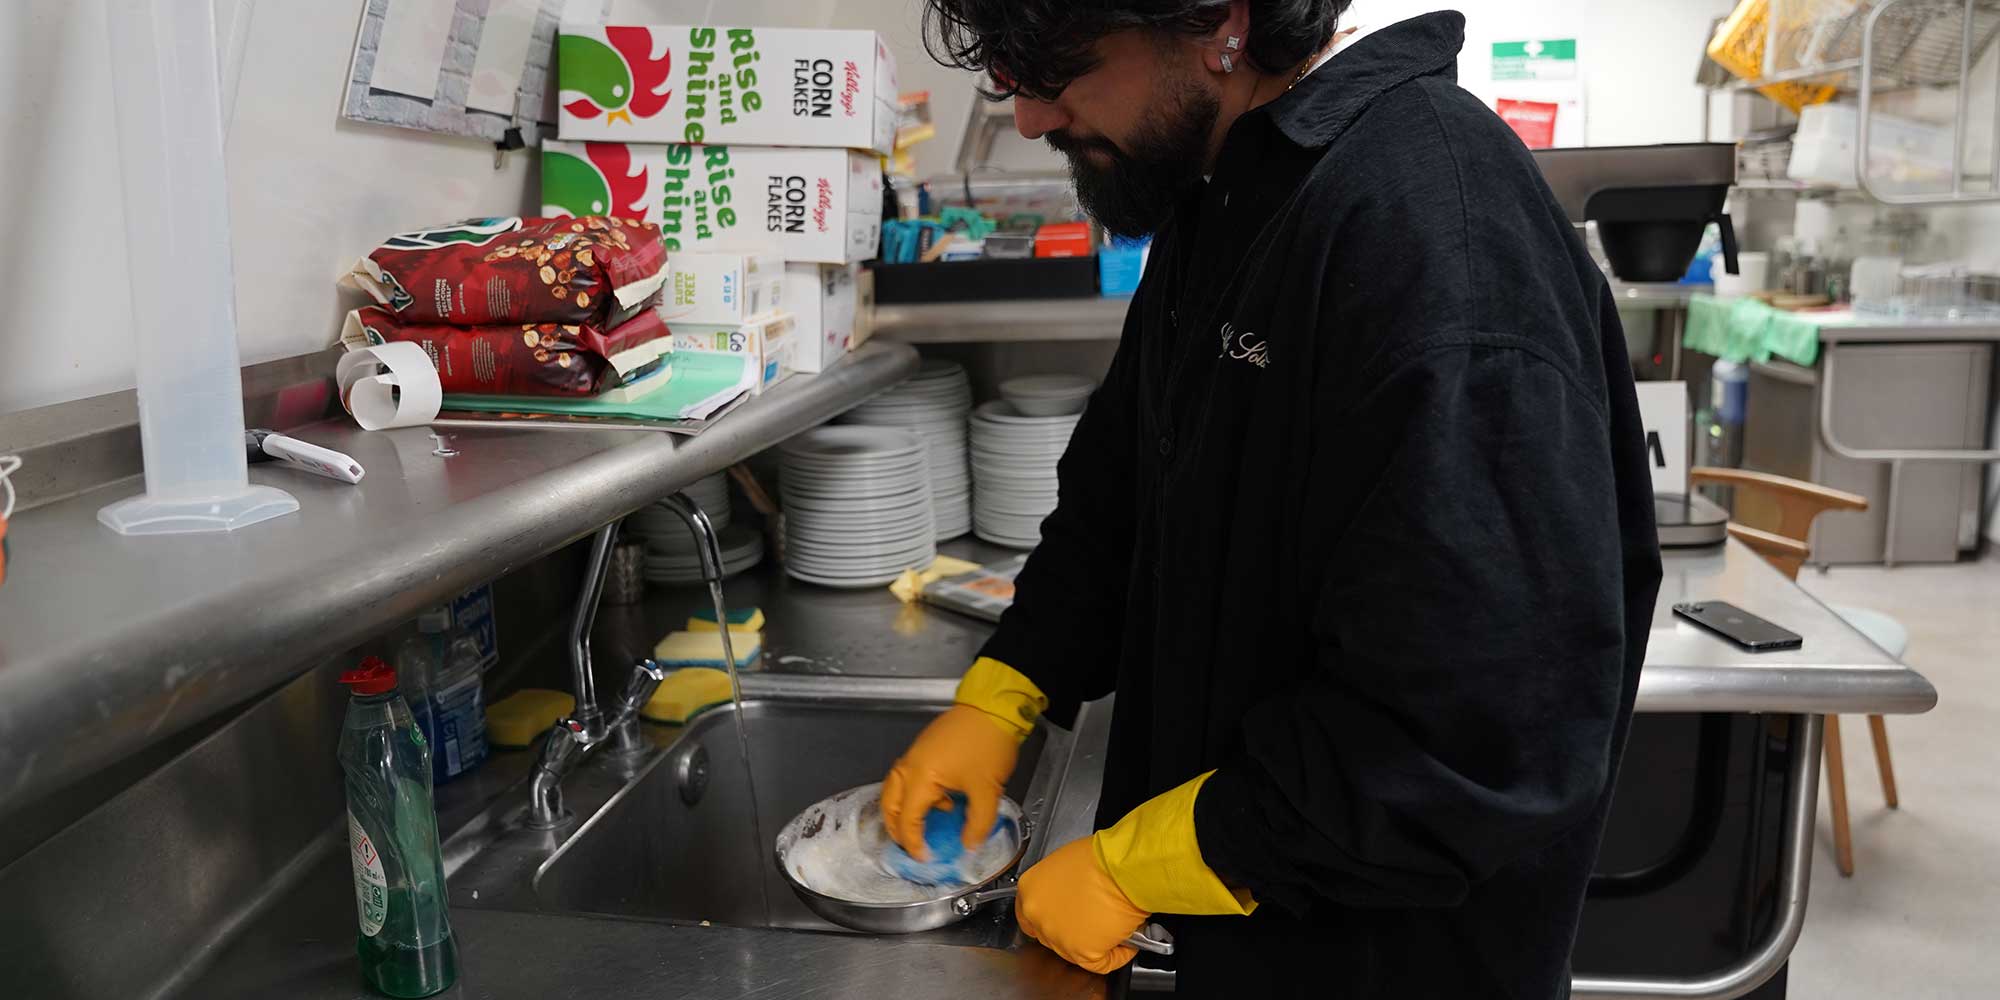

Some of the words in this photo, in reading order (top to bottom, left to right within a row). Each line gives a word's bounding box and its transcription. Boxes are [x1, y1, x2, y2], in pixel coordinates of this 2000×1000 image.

[684, 28, 716, 145] Shine
[718, 73, 738, 126] and
[727, 28, 763, 114] Rise
[793, 58, 810, 118] FLAKES
[811, 58, 834, 119] CORN
[840, 61, 860, 117] Kellogg's
[694, 189, 713, 241] and
[703, 145, 737, 229] Rise
[767, 175, 783, 233] FLAKES
[785, 175, 806, 234] CORN
[813, 177, 833, 233] Kellogg's
[675, 272, 683, 305] GLUTEN
[684, 273, 695, 304] FREE
